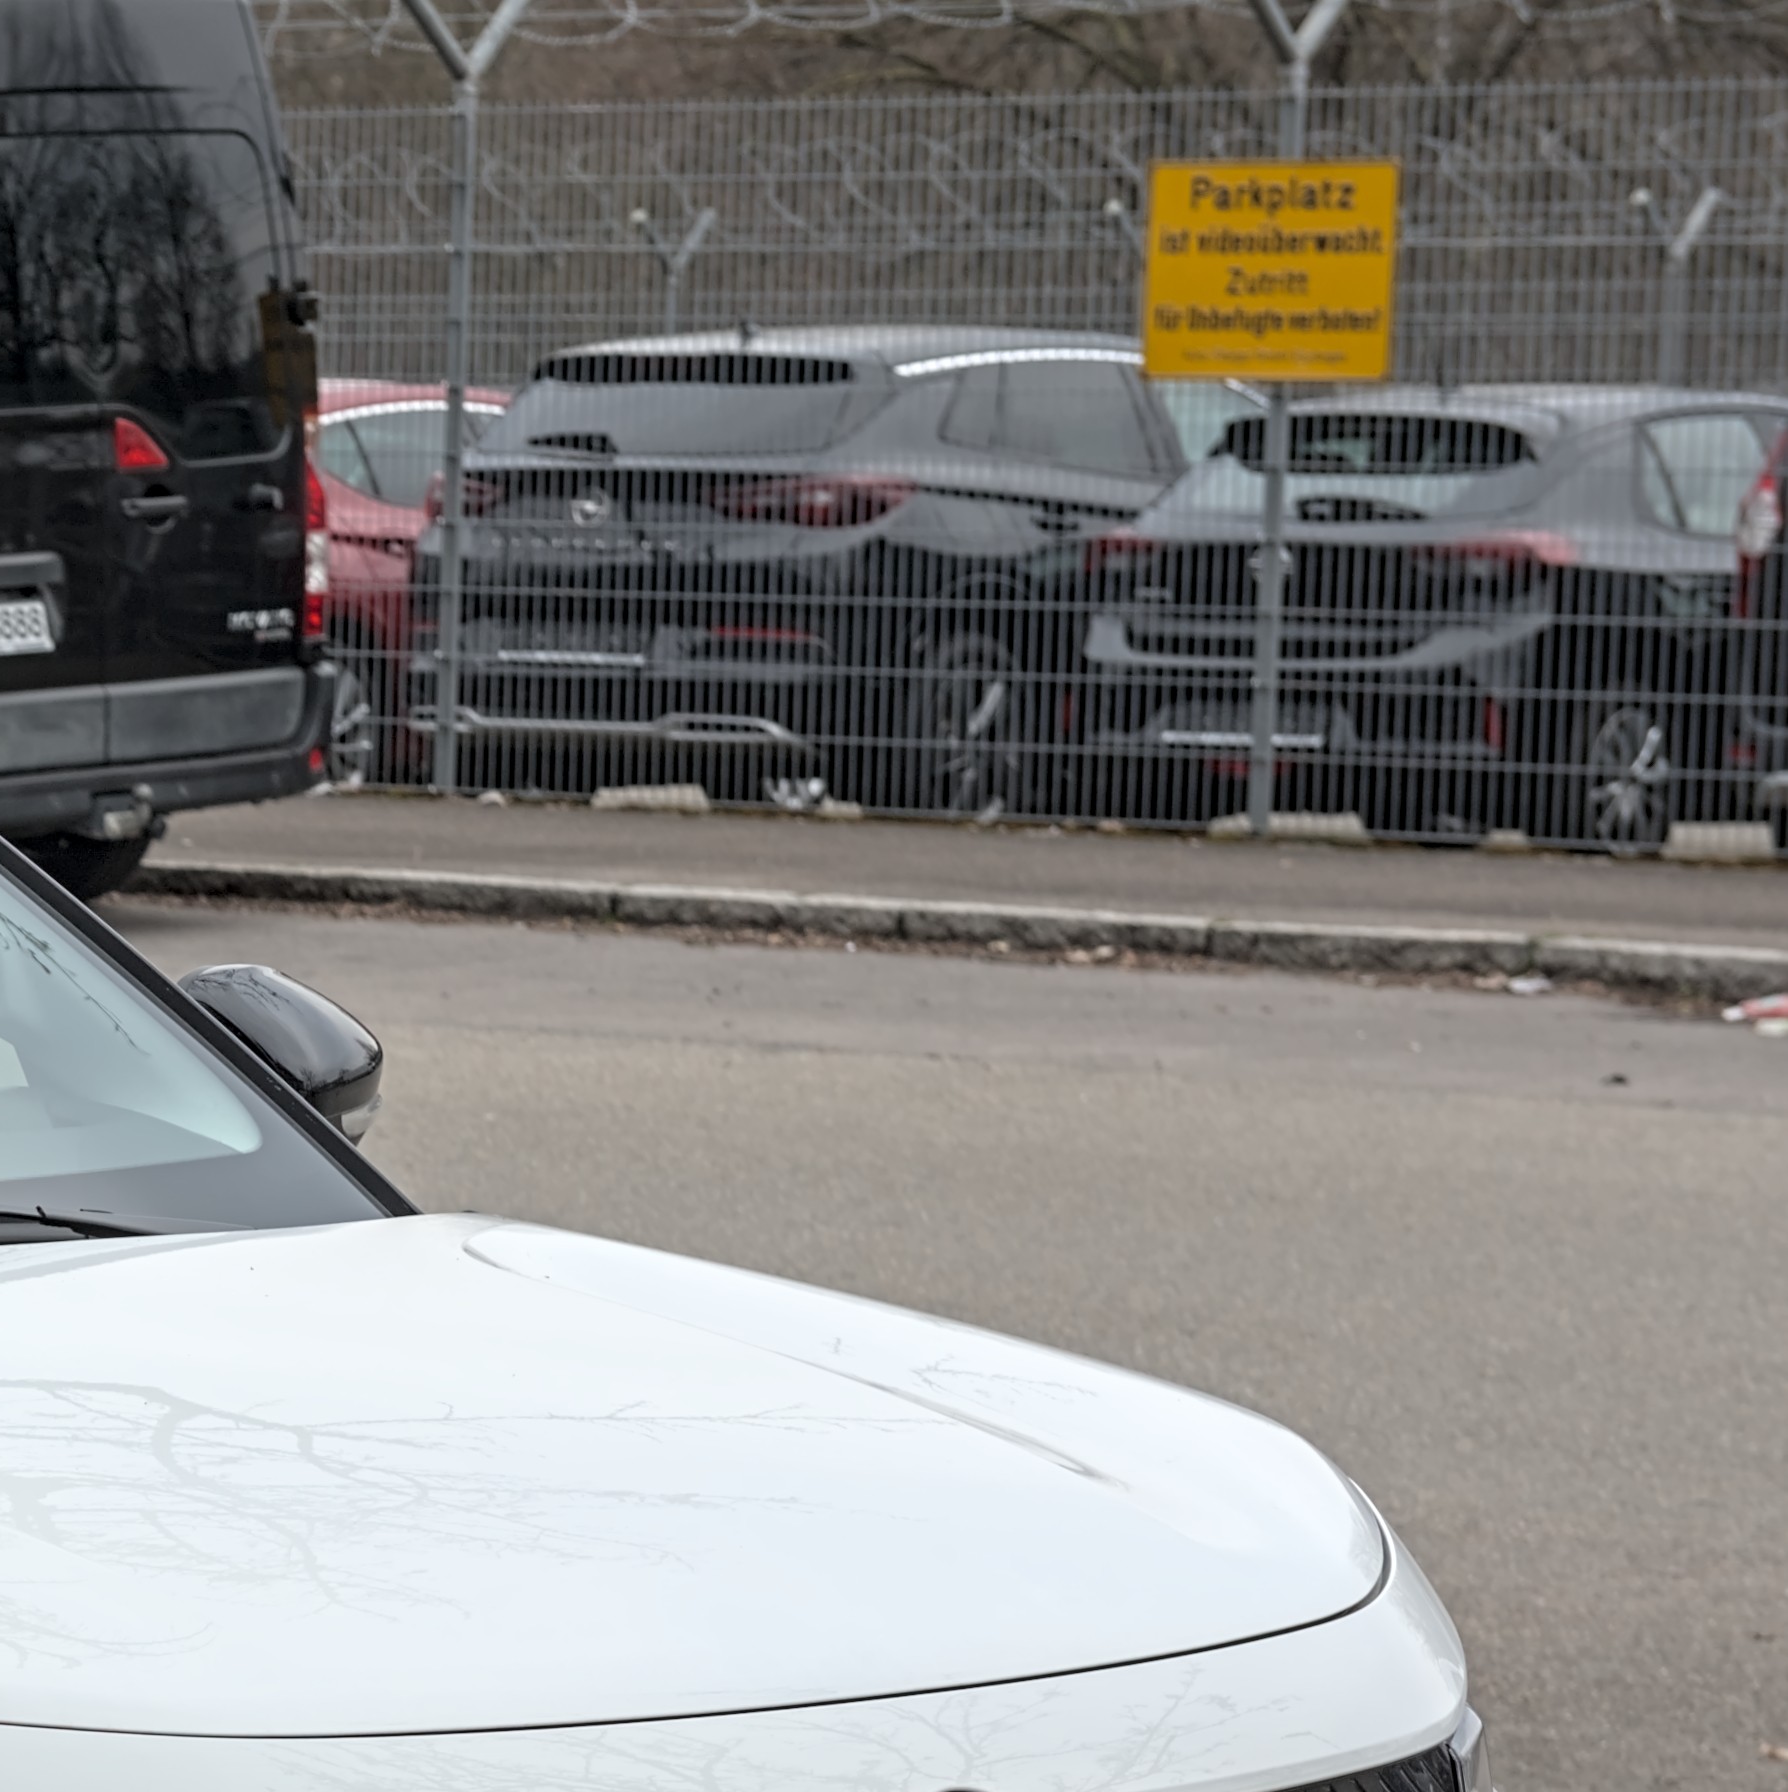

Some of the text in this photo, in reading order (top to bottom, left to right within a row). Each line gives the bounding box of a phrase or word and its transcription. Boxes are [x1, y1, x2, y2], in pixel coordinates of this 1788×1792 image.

[1189, 176, 1357, 214] Parkplatz
[1225, 265, 1308, 295] Zutritt
[1187, 305, 1282, 338] Unbefugte
